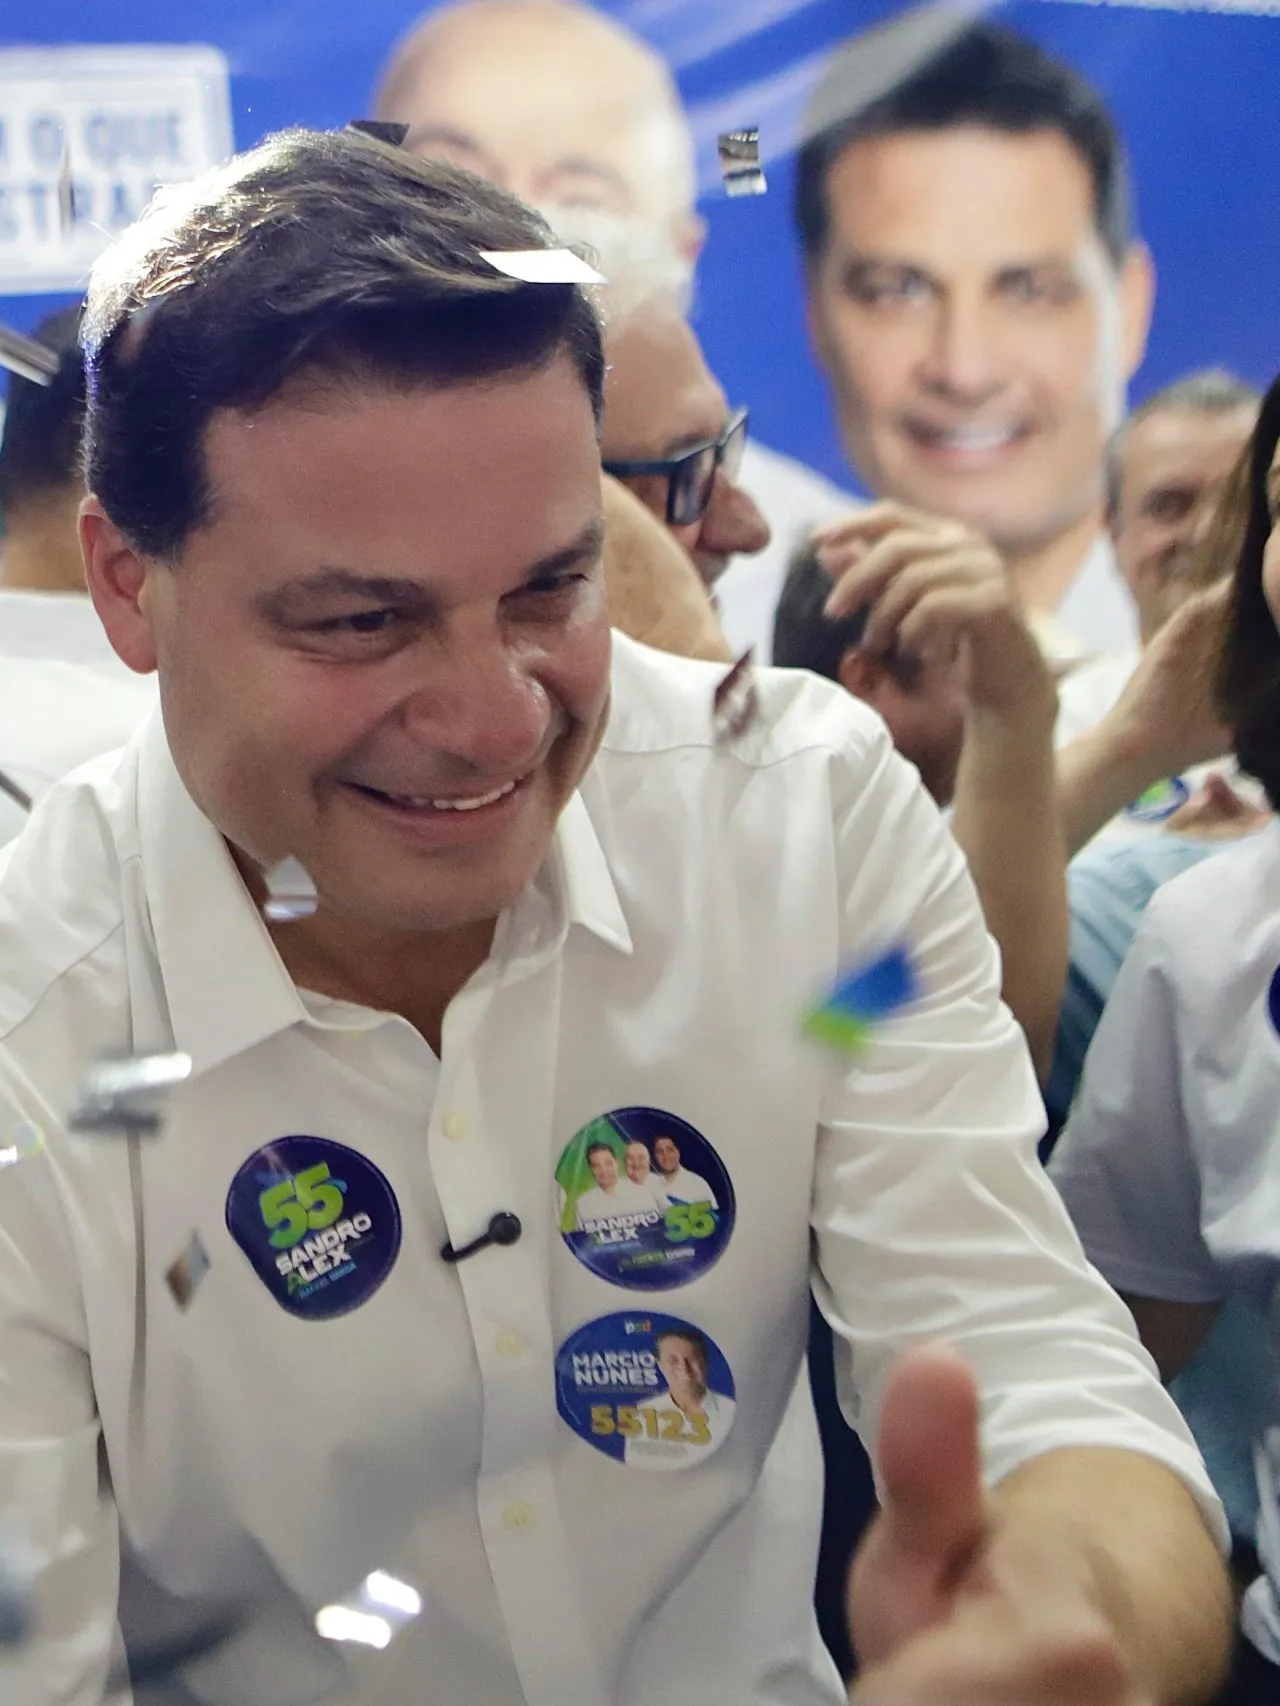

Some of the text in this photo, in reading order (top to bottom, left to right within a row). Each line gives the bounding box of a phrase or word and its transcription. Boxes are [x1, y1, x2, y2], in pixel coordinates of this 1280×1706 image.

[25, 112, 64, 167] O
[259, 1162, 344, 1249] 55
[583, 1210, 660, 1234] SANDRO
[664, 1200, 716, 1243] 55
[275, 1212, 373, 1276] SANDRO
[572, 1351, 657, 1371] MARCIO
[574, 1368, 659, 1387] NUNES
[591, 1404, 713, 1447] 55123
